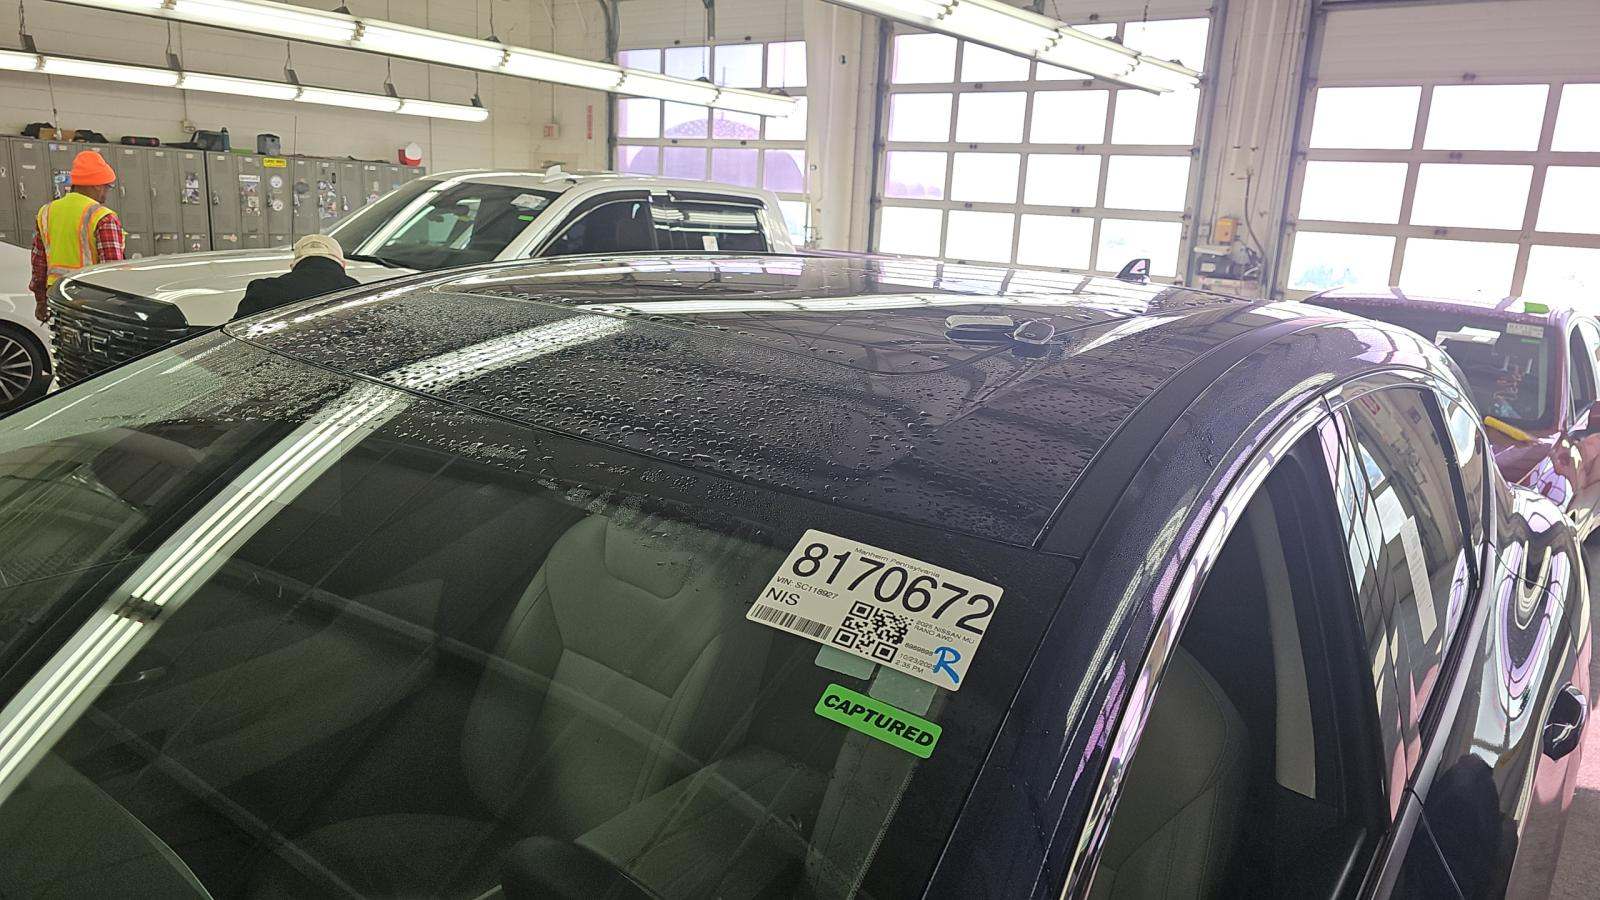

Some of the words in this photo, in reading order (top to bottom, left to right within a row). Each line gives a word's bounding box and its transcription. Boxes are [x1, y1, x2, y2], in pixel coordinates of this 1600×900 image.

[854, 547, 889, 563] Manheim
[890, 558, 941, 578] Pennsylvania
[765, 587, 801, 606] NIS
[776, 575, 794, 587] VIN:
[794, 581, 839, 600] SC118927
[792, 542, 995, 635] 8170672
[913, 625, 934, 636] RANO
[935, 633, 954, 643] AWD
[934, 626, 961, 640] NISSAN
[962, 635, 976, 645] MU
[894, 659, 911, 669] 2:35
[911, 665, 925, 674] PM
[933, 646, 961, 684] R
[823, 694, 934, 747] CAPTURED
